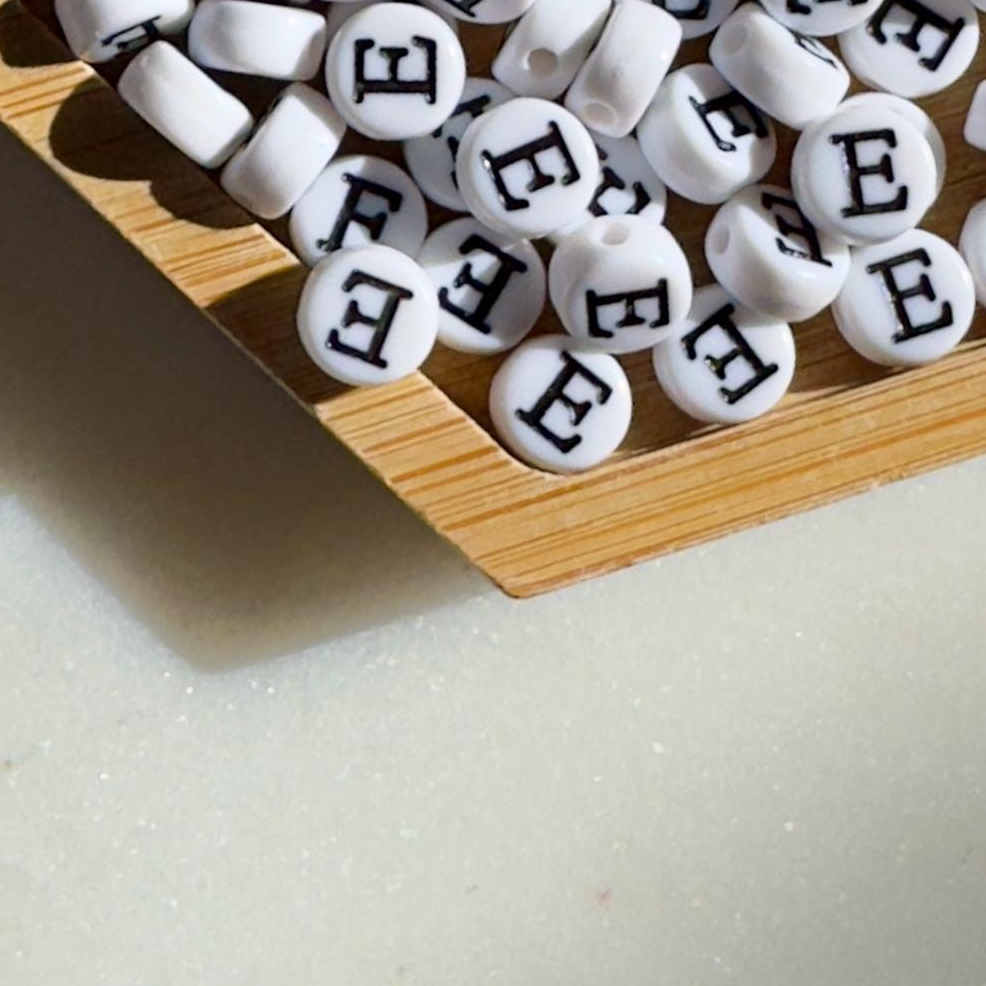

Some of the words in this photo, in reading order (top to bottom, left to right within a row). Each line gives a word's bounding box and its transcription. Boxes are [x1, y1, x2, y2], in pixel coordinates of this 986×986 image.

[353, 35, 438, 105] E
[481, 120, 581, 212] E
[829, 128, 909, 218] E
[325, 269, 414, 369] E
[438, 233, 528, 335] E
[585, 278, 670, 338] E
[866, 248, 954, 343] E
[515, 350, 613, 454] E
[681, 303, 779, 406] E
